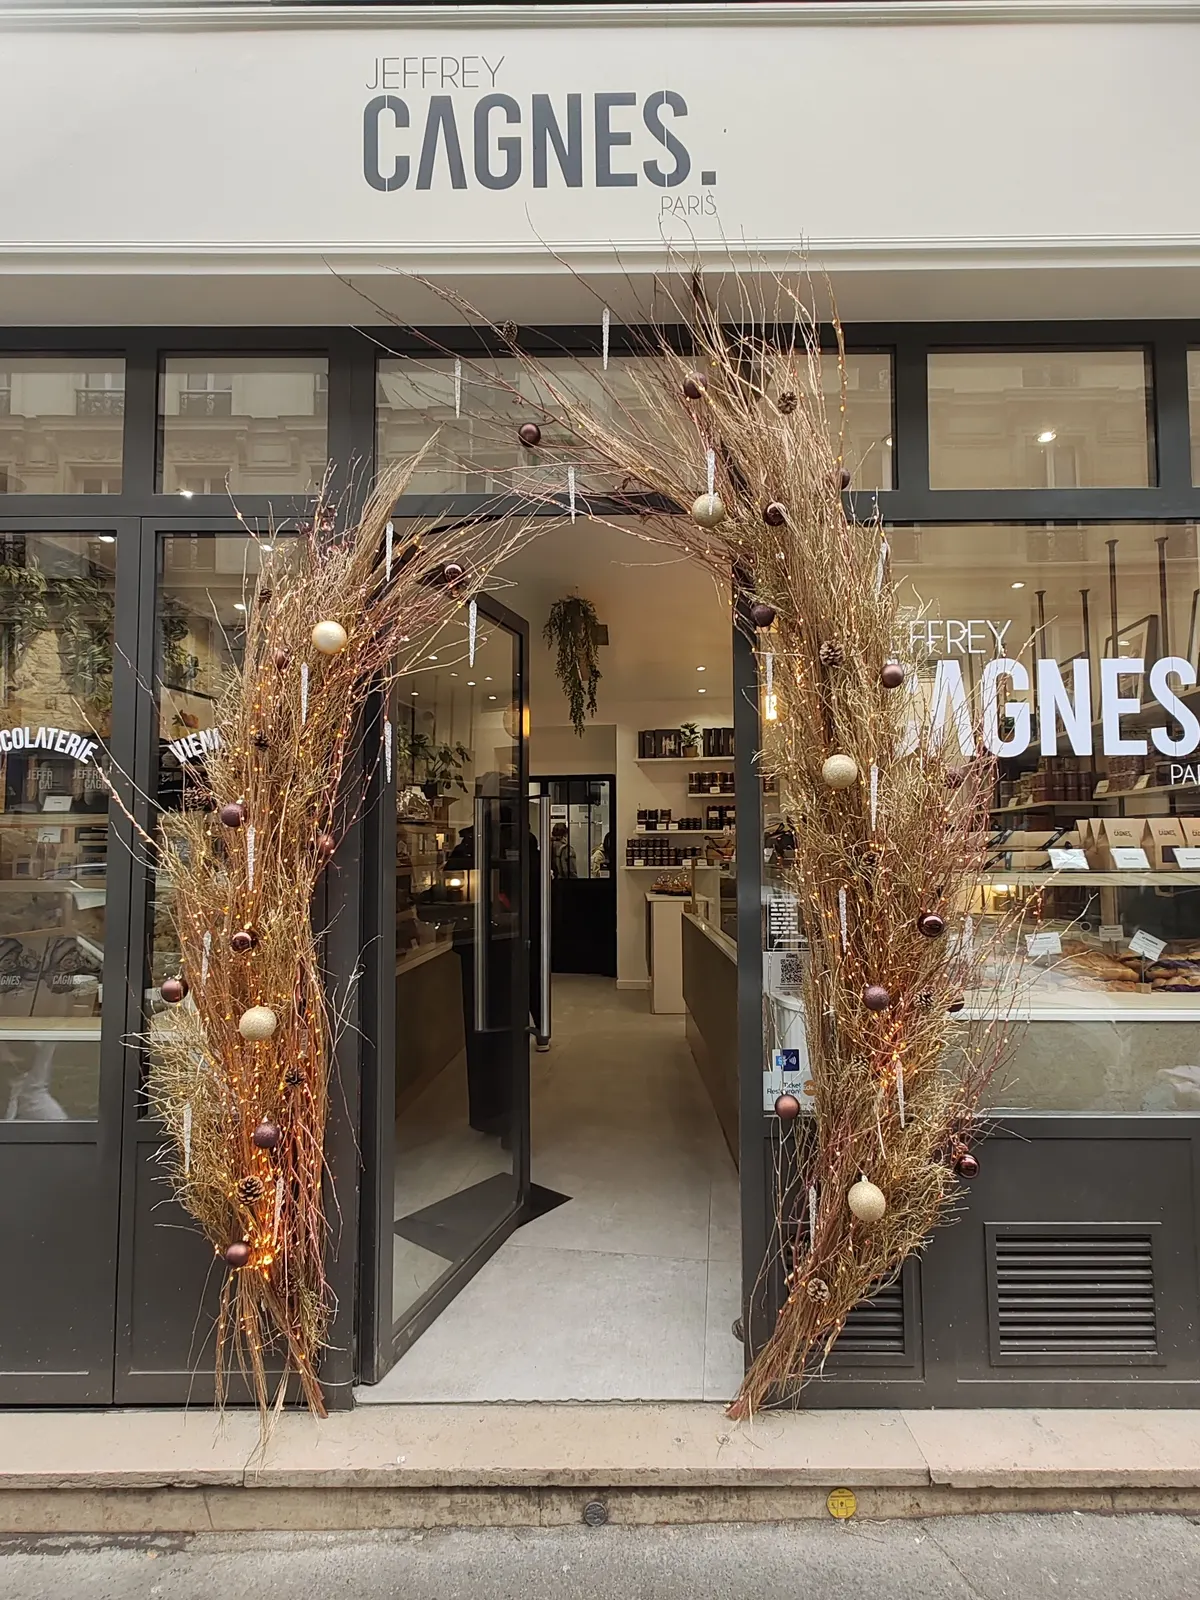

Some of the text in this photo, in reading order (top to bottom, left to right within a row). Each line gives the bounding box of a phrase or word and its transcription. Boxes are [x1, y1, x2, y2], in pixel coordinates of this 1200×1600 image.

[365, 55, 505, 90] JEFFREY
[660, 194, 717, 217] PARIS
[890, 619, 1012, 655] FFREY
[0, 726, 99, 765] COLATERIE
[167, 727, 222, 764] VIEN
